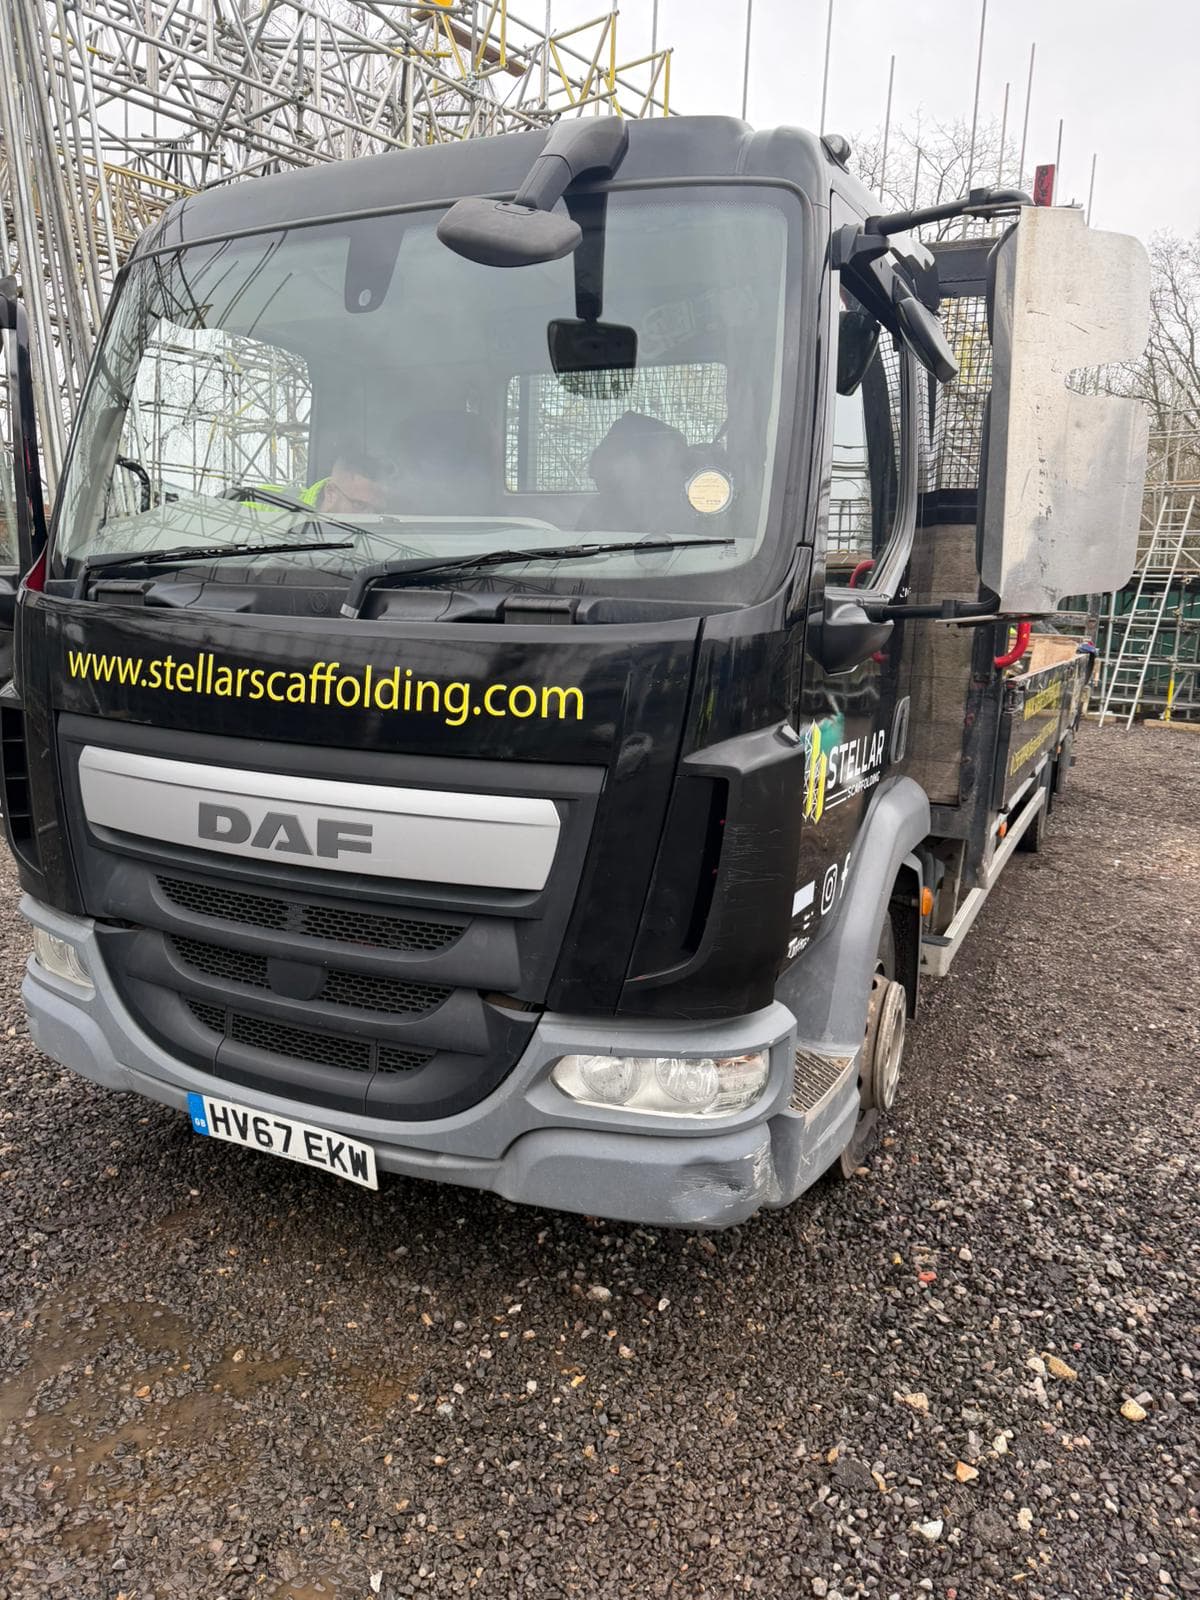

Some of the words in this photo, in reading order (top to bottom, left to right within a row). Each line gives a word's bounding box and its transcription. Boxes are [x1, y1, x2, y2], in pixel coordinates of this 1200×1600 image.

[68, 650, 584, 726] www.stellarscaffolding.com
[827, 729, 885, 789] STELLAR
[198, 802, 373, 859] DAF
[194, 1117, 207, 1128] GB
[209, 1103, 292, 1153] HV67
[304, 1130, 369, 1181] EKW
